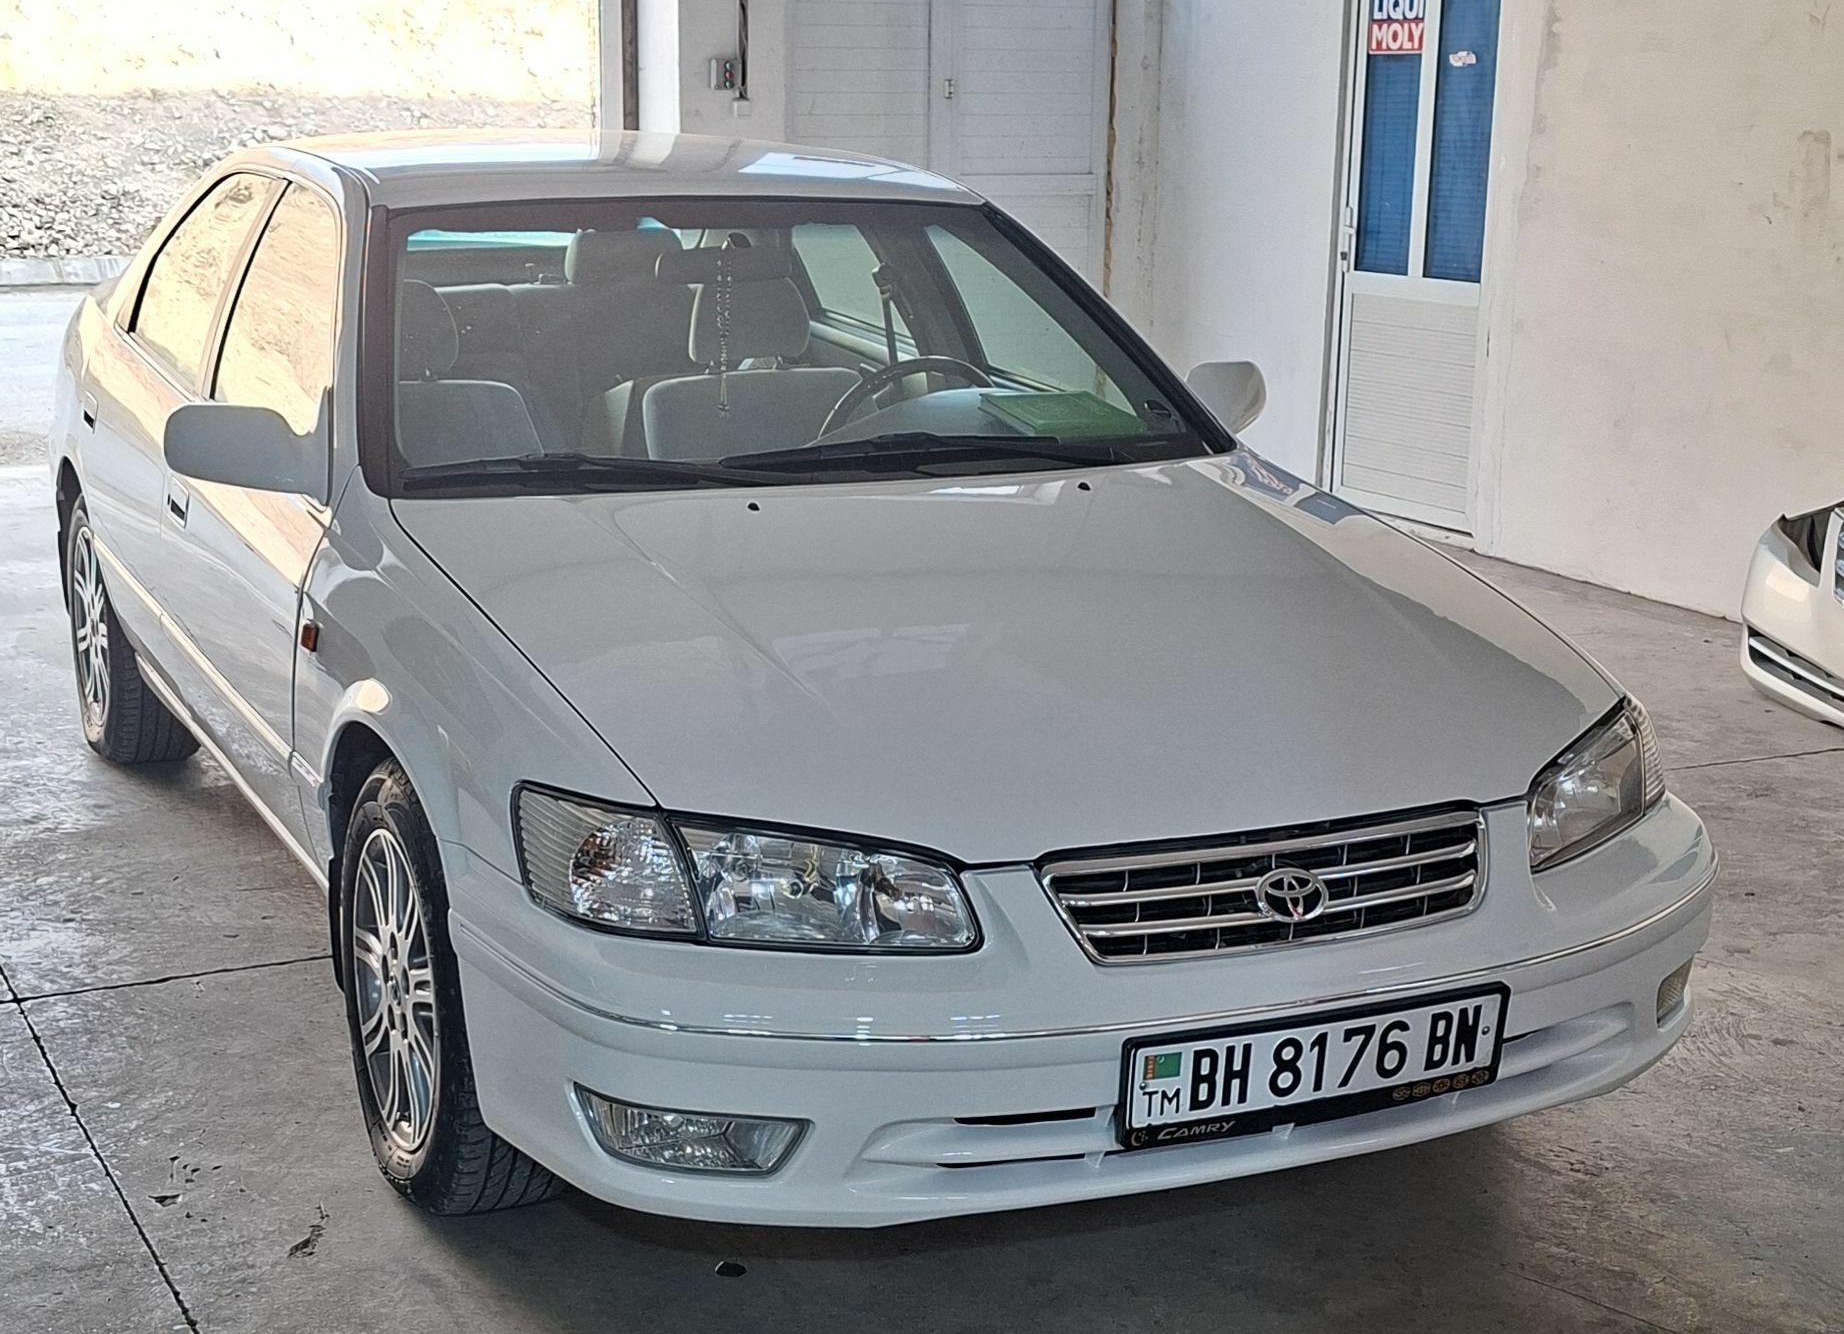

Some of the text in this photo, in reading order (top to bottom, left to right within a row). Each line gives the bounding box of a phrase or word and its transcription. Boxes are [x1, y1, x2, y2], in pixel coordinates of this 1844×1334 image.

[1371, 22, 1424, 50] MOLY
[1188, 1004, 1483, 1112] BH 8176 BN
[1142, 1087, 1181, 1118] TM
[1156, 1120, 1236, 1141] CAMRY
